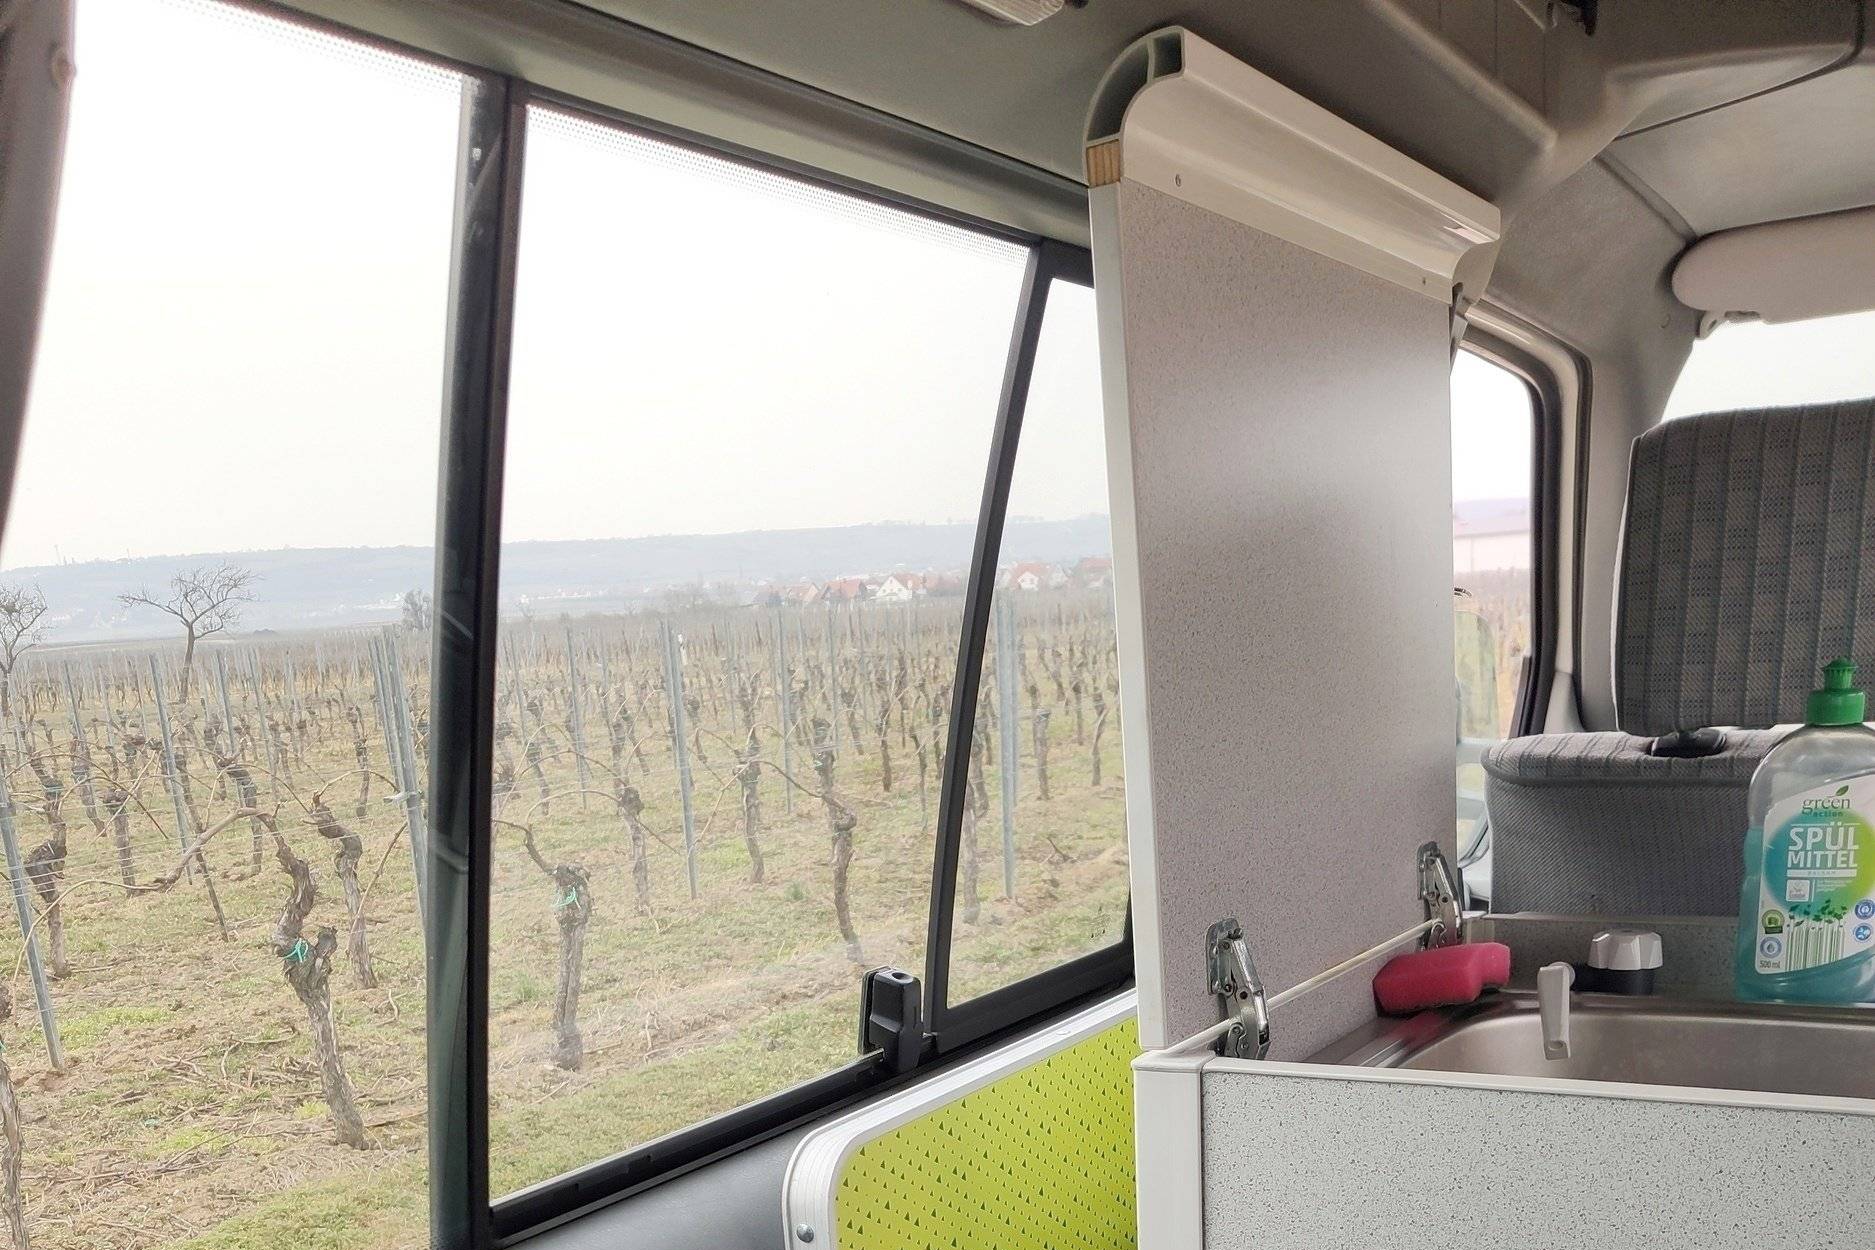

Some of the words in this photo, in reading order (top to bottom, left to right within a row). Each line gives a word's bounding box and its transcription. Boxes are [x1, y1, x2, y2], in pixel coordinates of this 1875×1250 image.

[1802, 798, 1851, 815] green
[1788, 821, 1859, 850] SPÜL
[1787, 850, 1858, 868] MITTEL
[1759, 960, 1772, 969] 500
[1772, 960, 1781, 969] ml
